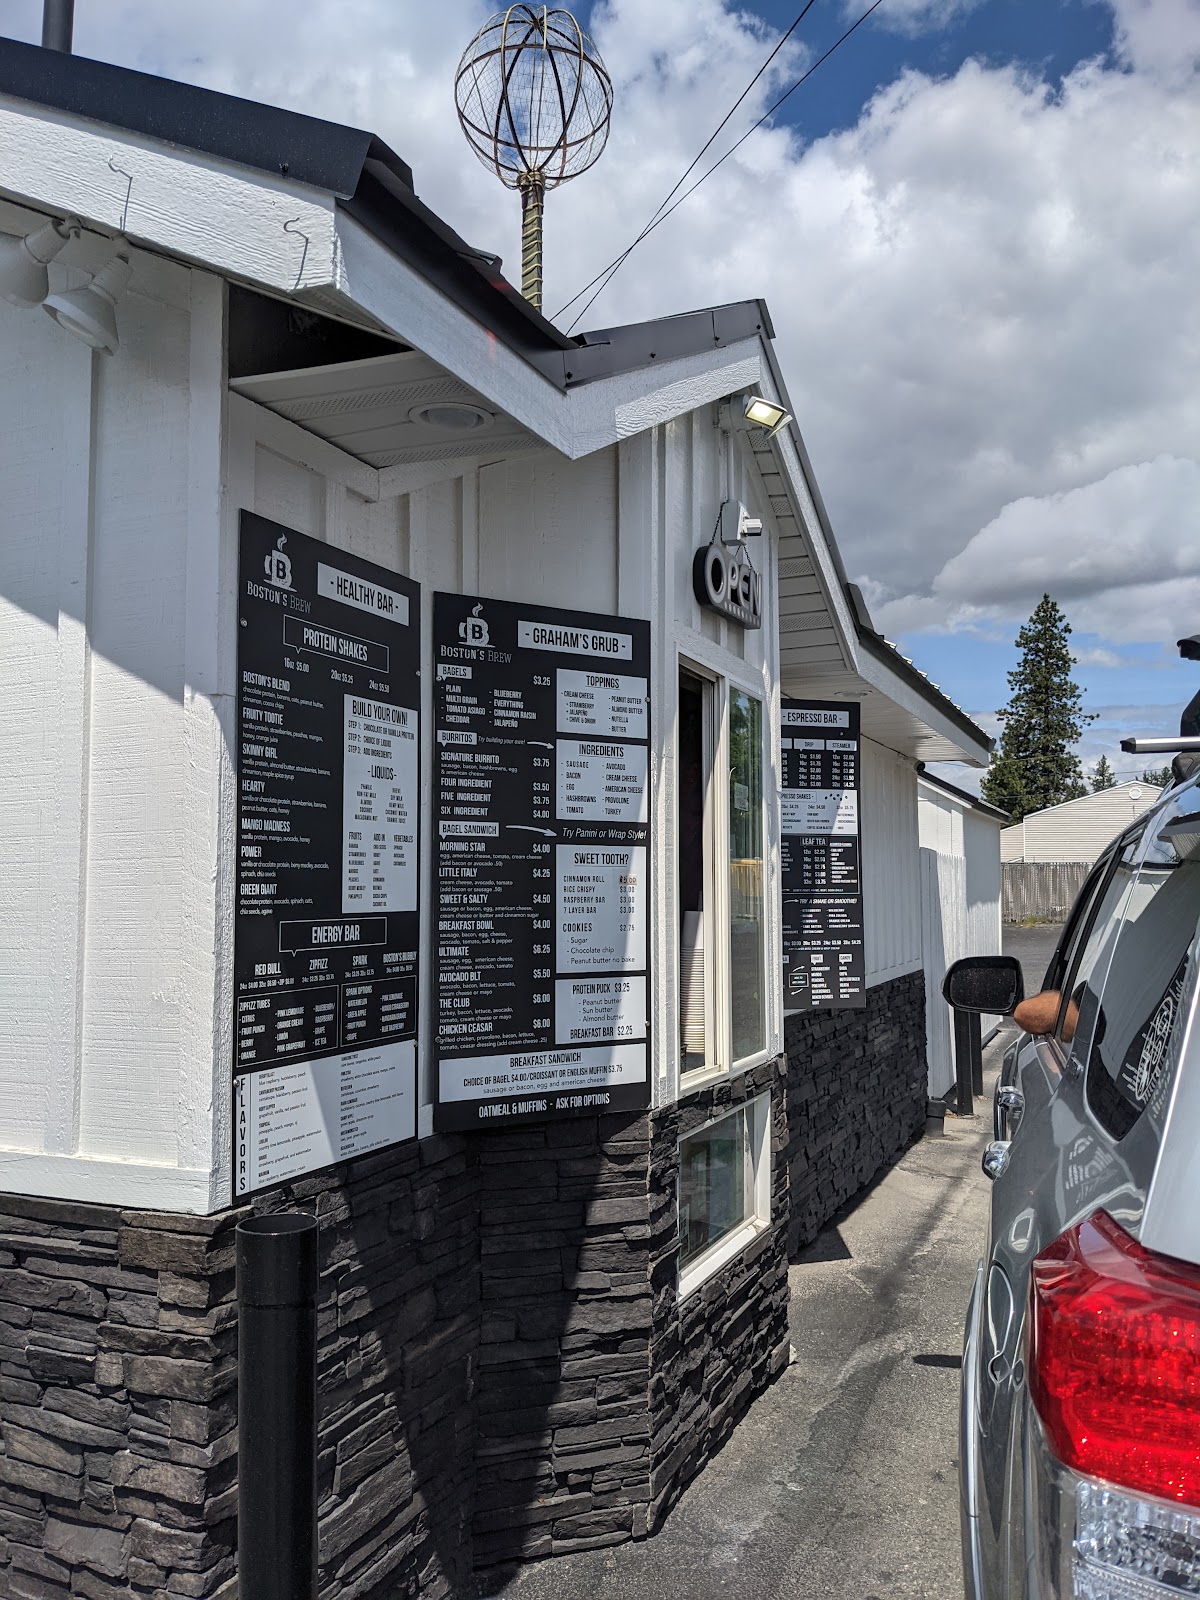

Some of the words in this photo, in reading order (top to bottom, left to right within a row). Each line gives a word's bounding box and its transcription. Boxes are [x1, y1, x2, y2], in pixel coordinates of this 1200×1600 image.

[705, 543, 762, 616] OPEN
[246, 581, 288, 606] BOSTON'S
[290, 599, 312, 614] BREW
[336, 576, 376, 607] HEALTHY
[378, 592, 394, 614] BAR
[304, 627, 338, 652] PROTEIN
[338, 638, 368, 662] SHAKES
[533, 628, 589, 650] GRAHAM'S
[591, 635, 619, 653] GRUB
[440, 645, 485, 661] BOSTON'S
[488, 650, 512, 664] BREW
[296, 660, 310, 673] $5.00
[442, 666, 466, 677] BAGELS
[243, 670, 271, 688] BOSTON'S
[272, 678, 290, 692] BLEND
[533, 675, 550, 686] $3.25
[586, 675, 620, 688] TOPPINGS
[446, 684, 461, 693] PLAIN
[494, 689, 522, 699] BLUEBERRY
[446, 705, 466, 714] TOMATO
[494, 699, 524, 709] EVERYTHING
[243, 707, 263, 721] FRUITY
[264, 711, 283, 725] TOOTIE
[353, 700, 372, 717] BUILD
[374, 705, 390, 722] YOUR
[392, 709, 408, 725] OWN!
[494, 709, 519, 718] CINNAMON
[788, 712, 822, 723] ESPRESSO
[824, 714, 838, 724] BAR
[446, 715, 470, 724] CHEDDAR
[442, 732, 473, 743] BURRITOS
[242, 743, 264, 757] SKINNY
[265, 746, 278, 759] GIRL
[579, 744, 624, 757] INGREDIENTS
[441, 751, 473, 762] SIGNATURE
[475, 754, 499, 764] BURRITO
[533, 757, 550, 767] $3.75
[566, 761, 589, 769] SAUSAGE
[242, 779, 265, 793] HEARTY
[441, 777, 456, 786] FOUR
[458, 779, 492, 788] INGREDIENT
[533, 782, 549, 792] $3.50
[441, 792, 454, 800] FIVE
[457, 793, 491, 802] INGREDIENT
[566, 795, 596, 803] HASHBROWNS
[441, 806, 451, 815] SIX
[454, 806, 488, 816] INGREDIENT
[533, 810, 549, 819] $4.00
[566, 806, 584, 814] TOMATO
[242, 818, 263, 831] MANGO
[264, 819, 290, 832] MADNESS
[442, 824, 462, 834] BAGEL
[464, 824, 497, 835] SANDWICH
[563, 828, 574, 838] Try
[576, 828, 597, 837] Panini
[608, 829, 626, 840] Wrap
[627, 830, 647, 840] Style!
[241, 846, 262, 857] POWER
[440, 842, 469, 852] MORNING
[470, 842, 486, 852] STAR
[533, 843, 550, 853] $4.00
[574, 853, 599, 864] SWEET
[601, 854, 629, 864] TOOTH?
[439, 868, 460, 877] LITTLE
[461, 868, 477, 877] ITALY
[533, 868, 550, 878] $4.25
[240, 884, 260, 895] GREEN
[261, 883, 277, 894] GIANT
[440, 894, 462, 904] SWEET
[463, 894, 468, 904] &
[469, 894, 488, 904] SALTY
[533, 894, 550, 904] $4.50
[439, 921, 475, 931] BREAKFAST
[476, 921, 494, 930] BOWL
[533, 920, 550, 929] $4.00
[563, 923, 592, 932] COOKIES
[312, 925, 343, 944] ENERGY
[345, 924, 360, 941] BAR
[571, 937, 588, 945] Sugar
[439, 947, 469, 956] ULTIMATE
[533, 944, 550, 954] $6.25
[309, 958, 328, 970] ZIPFIZZ
[353, 955, 368, 966] SPARK
[571, 957, 591, 965] Peanut
[255, 964, 266, 976] RED
[267, 962, 281, 975] BULL
[533, 969, 550, 979] $5.50
[439, 972, 469, 982] AVOCADO
[470, 971, 481, 981] BLT
[573, 984, 595, 995] PROTEIN
[597, 983, 610, 994] PUCK
[614, 983, 630, 993] $3.25
[439, 999, 452, 1008] THE
[453, 998, 470, 1007] CLUB
[533, 994, 550, 1004] $6.00
[240, 1001, 256, 1012] ZIPFIZZ
[256, 999, 271, 1009] TUBES
[439, 1024, 467, 1035] CHICKEN
[468, 1022, 493, 1033] CEASAR
[533, 1019, 550, 1029] $6.00
[570, 1027, 601, 1039] BREAKFAST
[602, 1027, 614, 1037] BAR
[510, 1054, 547, 1068] BREAKFAST
[548, 1052, 582, 1064] SANDWICH
[464, 1077, 484, 1087] CHOICE
[484, 1076, 492, 1085] OF
[492, 1074, 510, 1085] BAGEL
[559, 1069, 566, 1078] OR
[567, 1067, 588, 1078] ENGLISH
[589, 1065, 607, 1076] MUFFIN
[479, 1103, 511, 1118] OATMEAL
[512, 1102, 517, 1114] &
[518, 1099, 547, 1113] MUFFINS
[556, 1097, 569, 1109] ASK
[570, 1095, 582, 1107] FOR
[583, 1093, 610, 1105] OPTIONS
